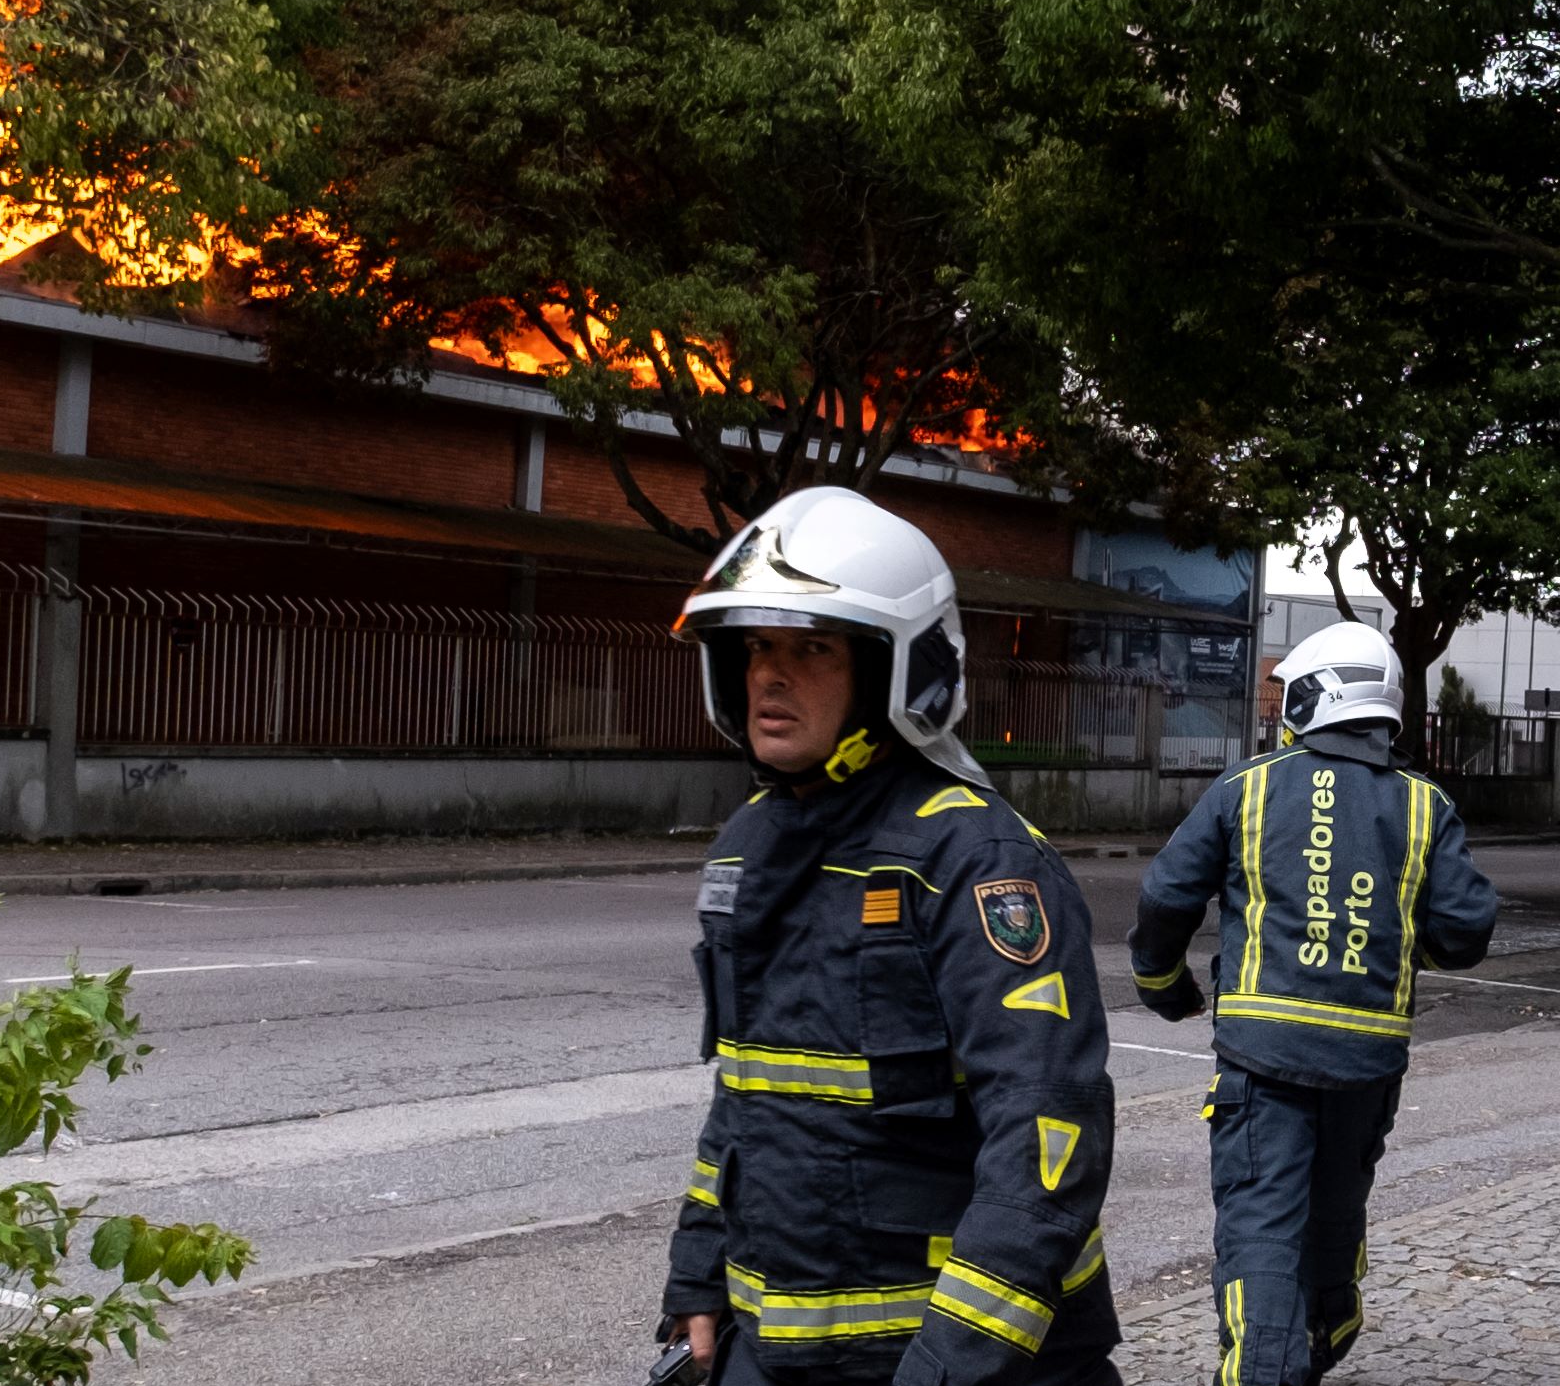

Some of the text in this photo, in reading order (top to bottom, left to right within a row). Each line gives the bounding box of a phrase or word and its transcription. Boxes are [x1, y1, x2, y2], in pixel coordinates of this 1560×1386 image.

[1327, 689, 1344, 703] 34
[981, 884, 1035, 898] PORTO
[1298, 769, 1336, 968] Sapadores
[1342, 871, 1374, 975] Porto
